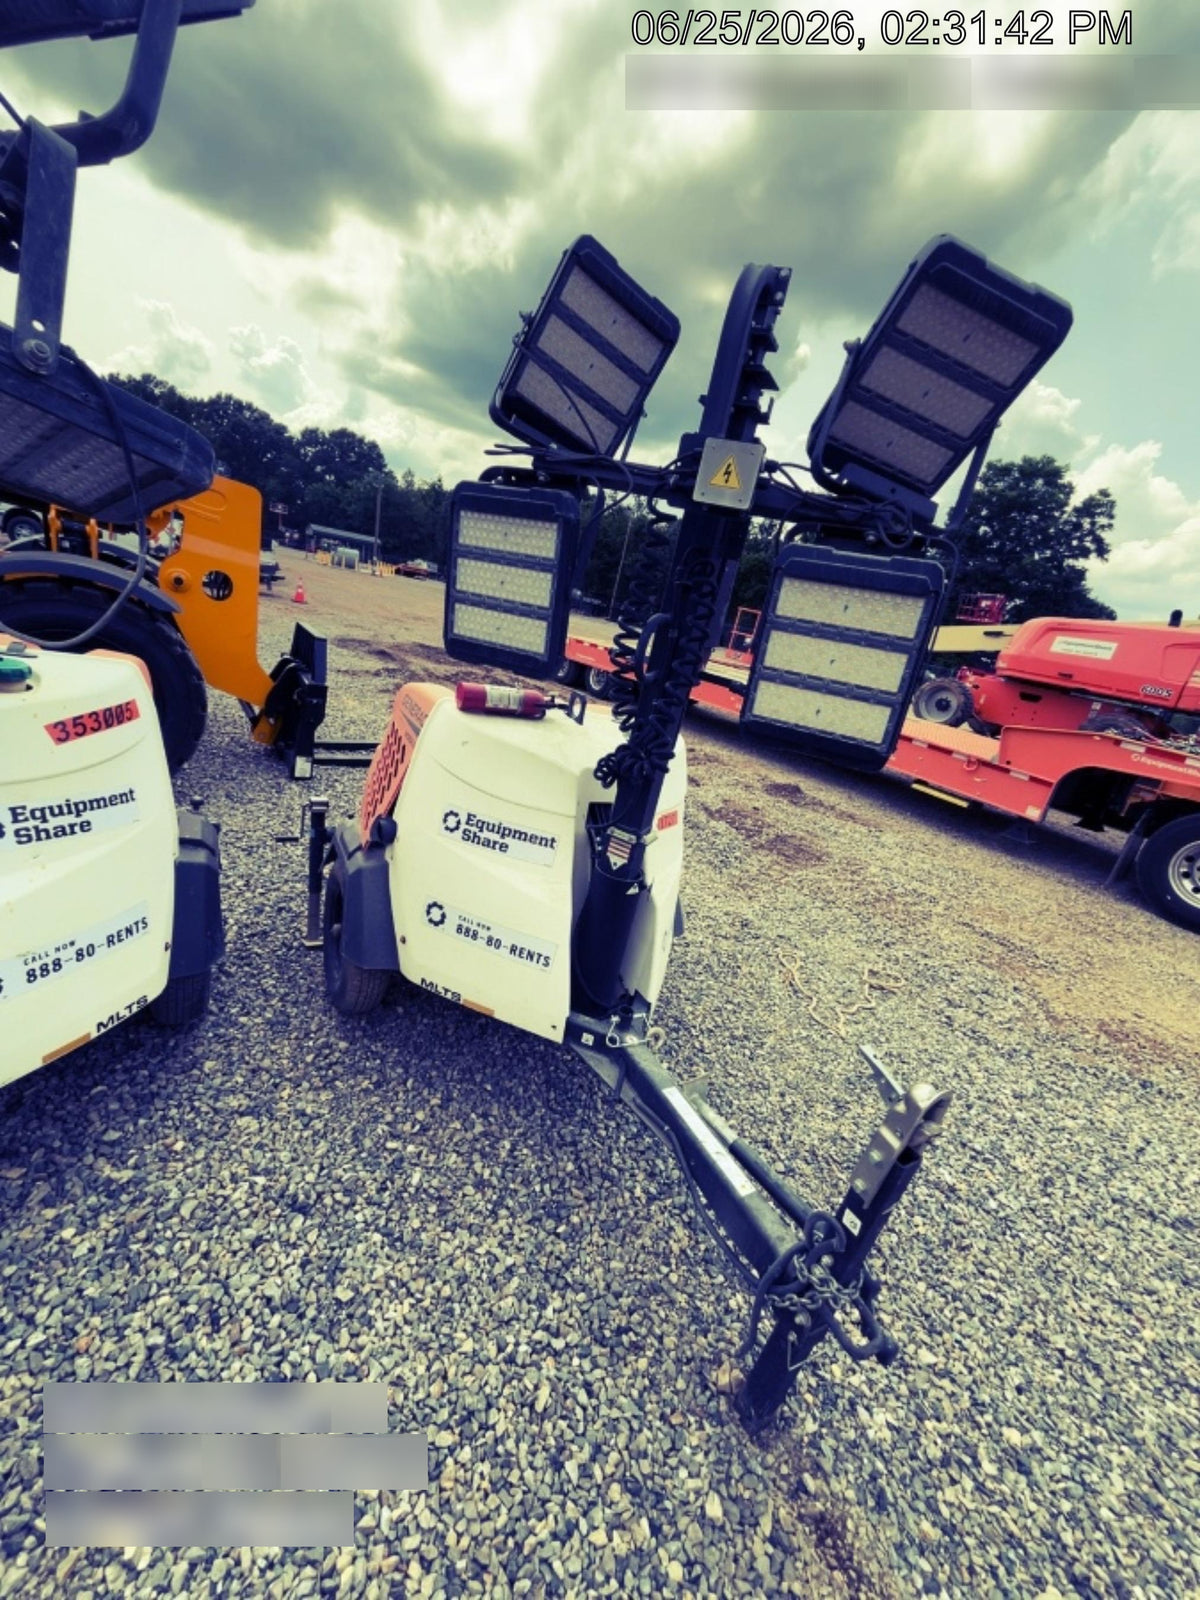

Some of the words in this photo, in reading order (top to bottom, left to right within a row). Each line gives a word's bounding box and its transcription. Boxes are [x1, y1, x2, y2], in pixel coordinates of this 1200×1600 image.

[53, 702, 134, 743] 353005
[8, 787, 136, 824] Equipment
[13, 819, 92, 845] Share
[461, 828, 510, 853] Share
[465, 812, 557, 850] Equipment
[24, 951, 51, 966] CALL
[54, 940, 76, 953] NOW
[26, 916, 149, 984] 888-80-RENTS
[456, 923, 551, 968] 888-80-RENTS
[420, 977, 462, 1001] MLTS
[96, 995, 148, 1033] MLTS
